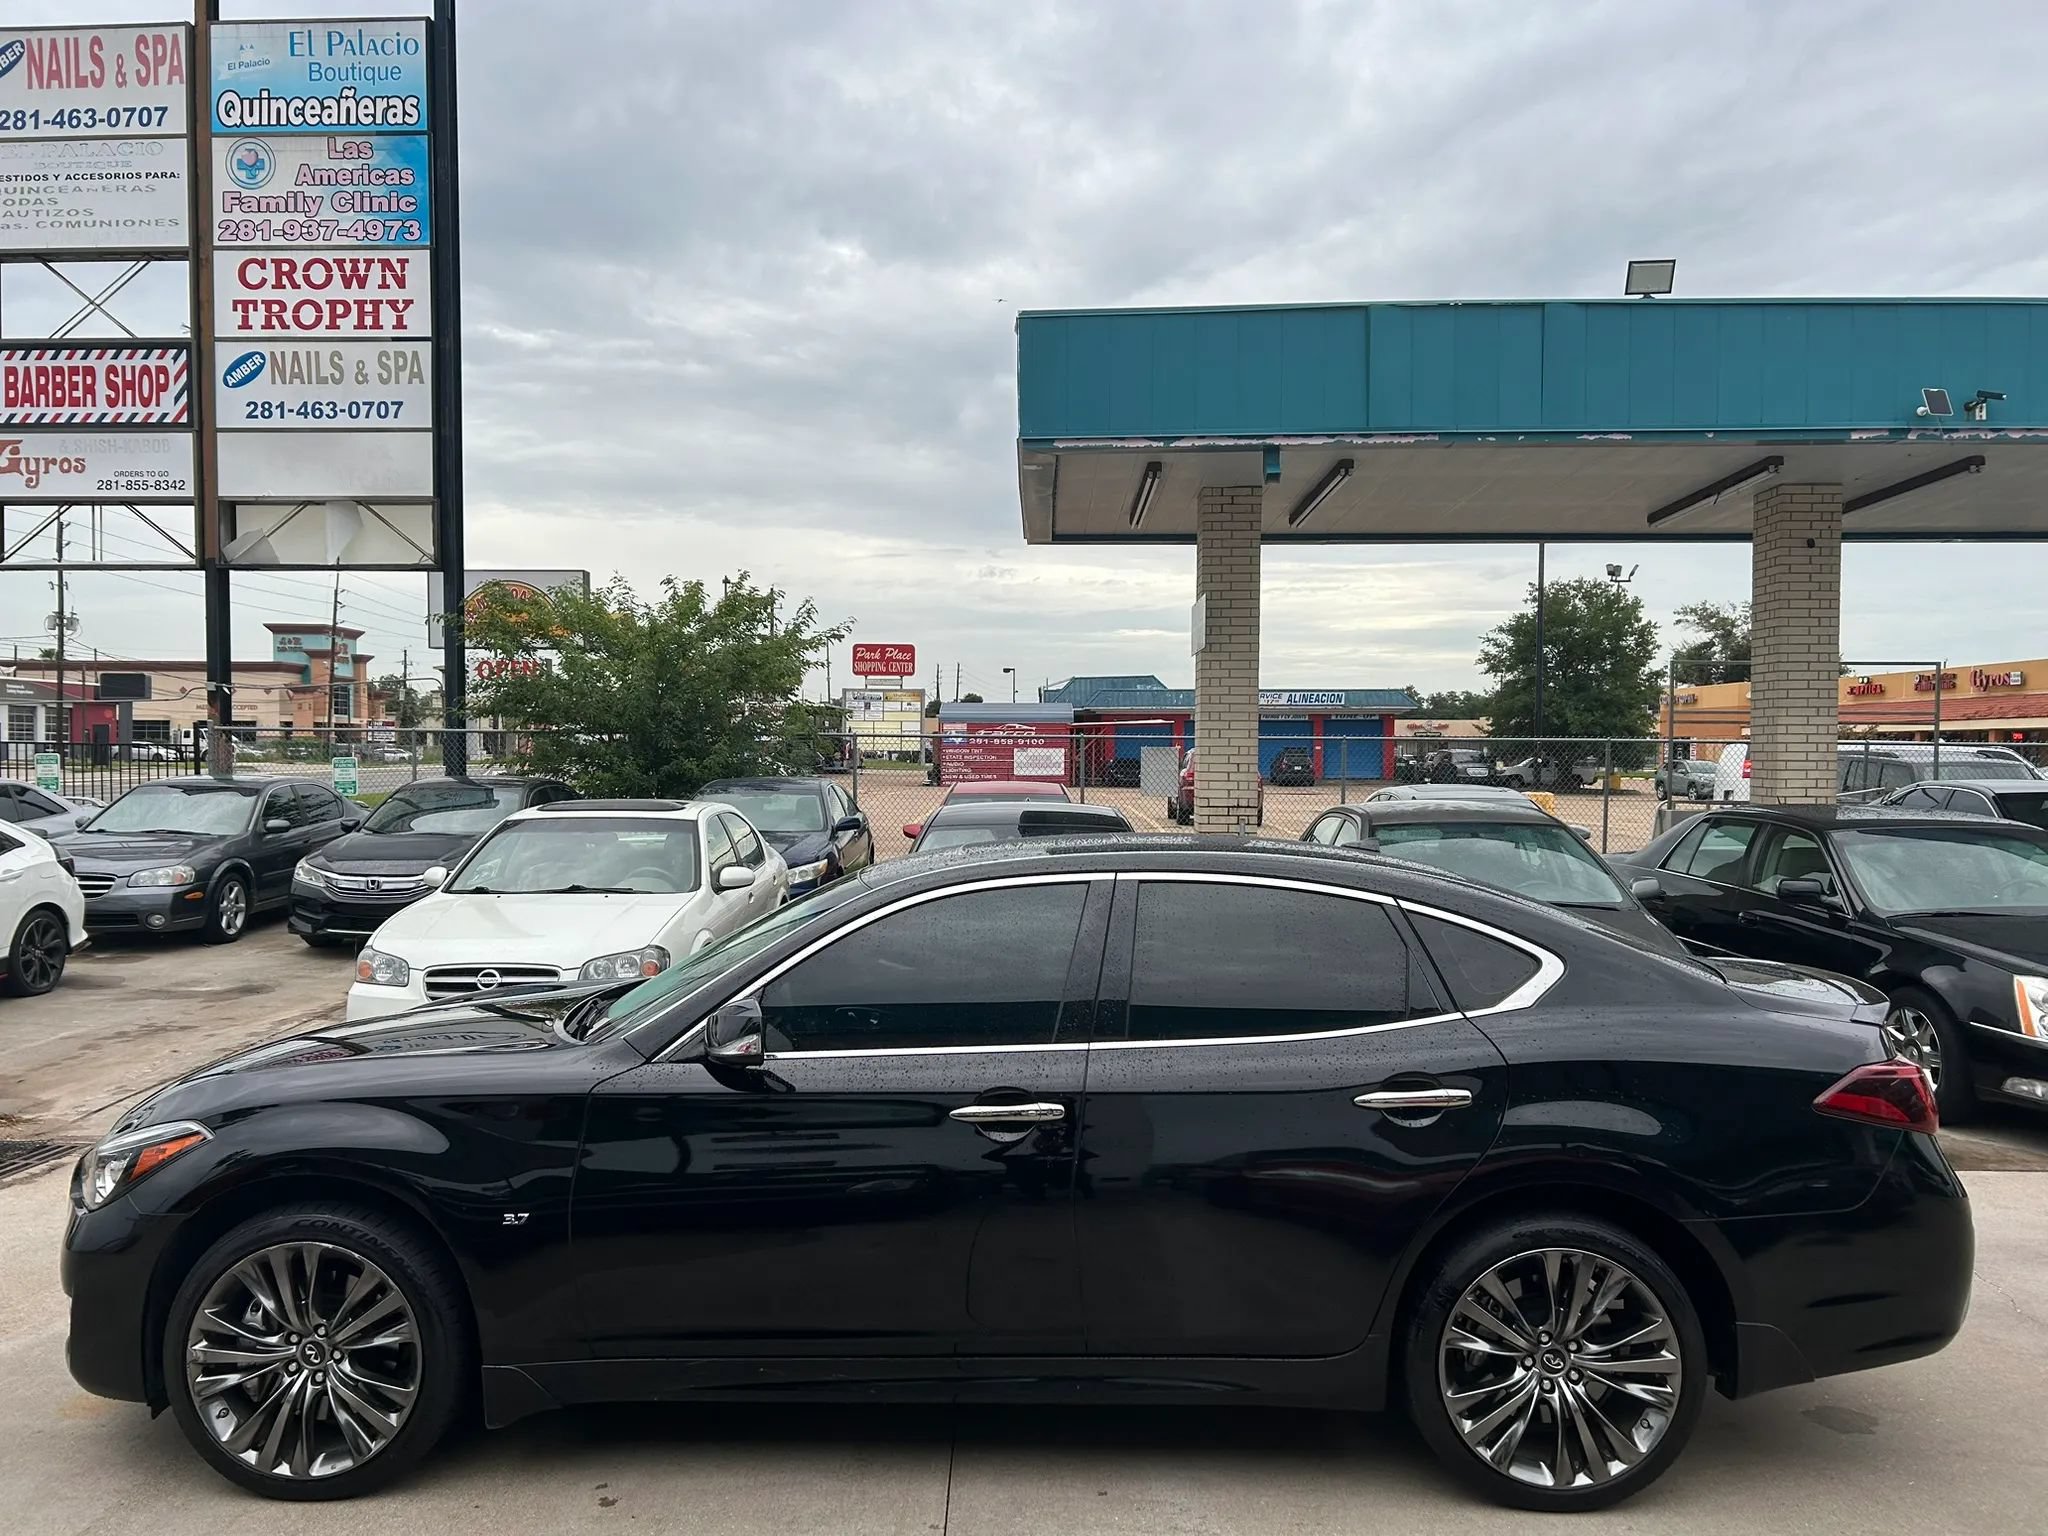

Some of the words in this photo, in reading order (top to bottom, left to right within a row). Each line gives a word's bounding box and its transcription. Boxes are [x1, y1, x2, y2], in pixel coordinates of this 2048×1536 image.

[289, 30, 315, 57] El
[327, 29, 420, 57] Palacio
[26, 35, 105, 89] NAILS
[115, 53, 127, 88] &
[135, 33, 184, 87] SPA
[227, 63, 237, 72] El
[238, 58, 271, 70] Palacio
[308, 62, 401, 85] Boutique
[0, 106, 168, 130] 281-463-0707
[217, 86, 420, 128] Quinceañeras
[41, 142, 164, 158] PALACIO
[327, 137, 374, 160] Las
[33, 160, 133, 170] BOUTIQUE
[295, 164, 415, 186] Americas
[53, 174, 60, 182] Y
[65, 172, 142, 182] ACCESORIOS
[145, 171, 180, 180] PARA:
[222, 191, 324, 217] Family
[331, 191, 418, 213] Clinic
[36, 218, 180, 229] COMUNIONES
[218, 219, 421, 241] 281-937-4973
[237, 257, 409, 290] CROWN
[232, 299, 414, 330] TROPHY
[225, 354, 264, 387] AMBER
[269, 350, 345, 385] NAILS
[354, 359, 370, 385] &
[377, 350, 425, 385] SPA
[4, 365, 97, 408] BARBER
[105, 364, 170, 408] SHOP
[245, 401, 404, 420] 281-463-0707
[97, 480, 186, 491] 281-855-8342
[856, 647, 881, 660] Park
[885, 647, 912, 660] Place
[854, 661, 887, 673] SHOPPING
[889, 661, 913, 673] CENTER
[1971, 669, 2010, 692] Gyros
[1286, 693, 1344, 704] ALINEACION
[503, 1213, 529, 1224] 3.7
